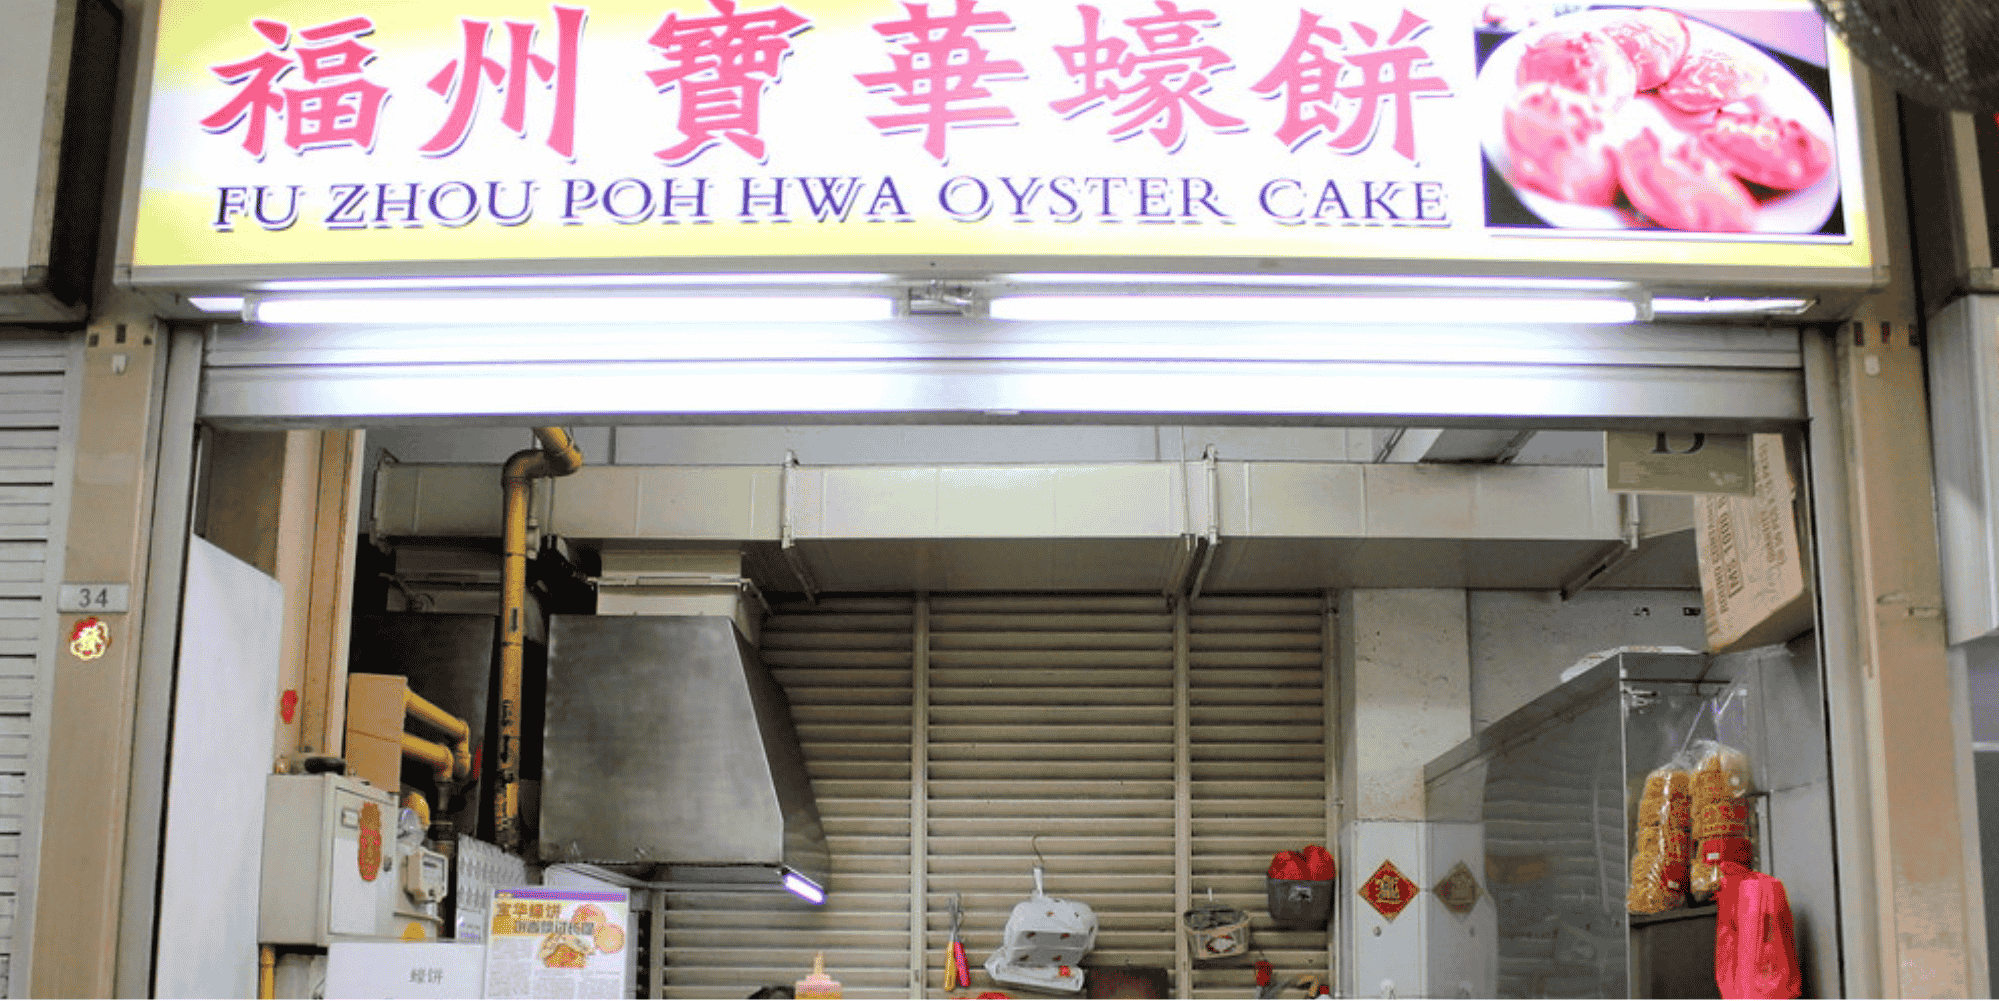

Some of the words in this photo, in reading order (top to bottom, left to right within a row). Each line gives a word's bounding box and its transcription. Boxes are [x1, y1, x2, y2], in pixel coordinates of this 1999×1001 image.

[200, 0, 1450, 167] 福州寶華蠔餅
[214, 185, 299, 229] FU
[325, 182, 533, 228] ZHOU
[561, 177, 708, 223] POH
[739, 176, 911, 222] HWA
[937, 176, 1231, 220] OYSTER
[1257, 179, 1448, 222] CAKE
[79, 588, 108, 608] 34
